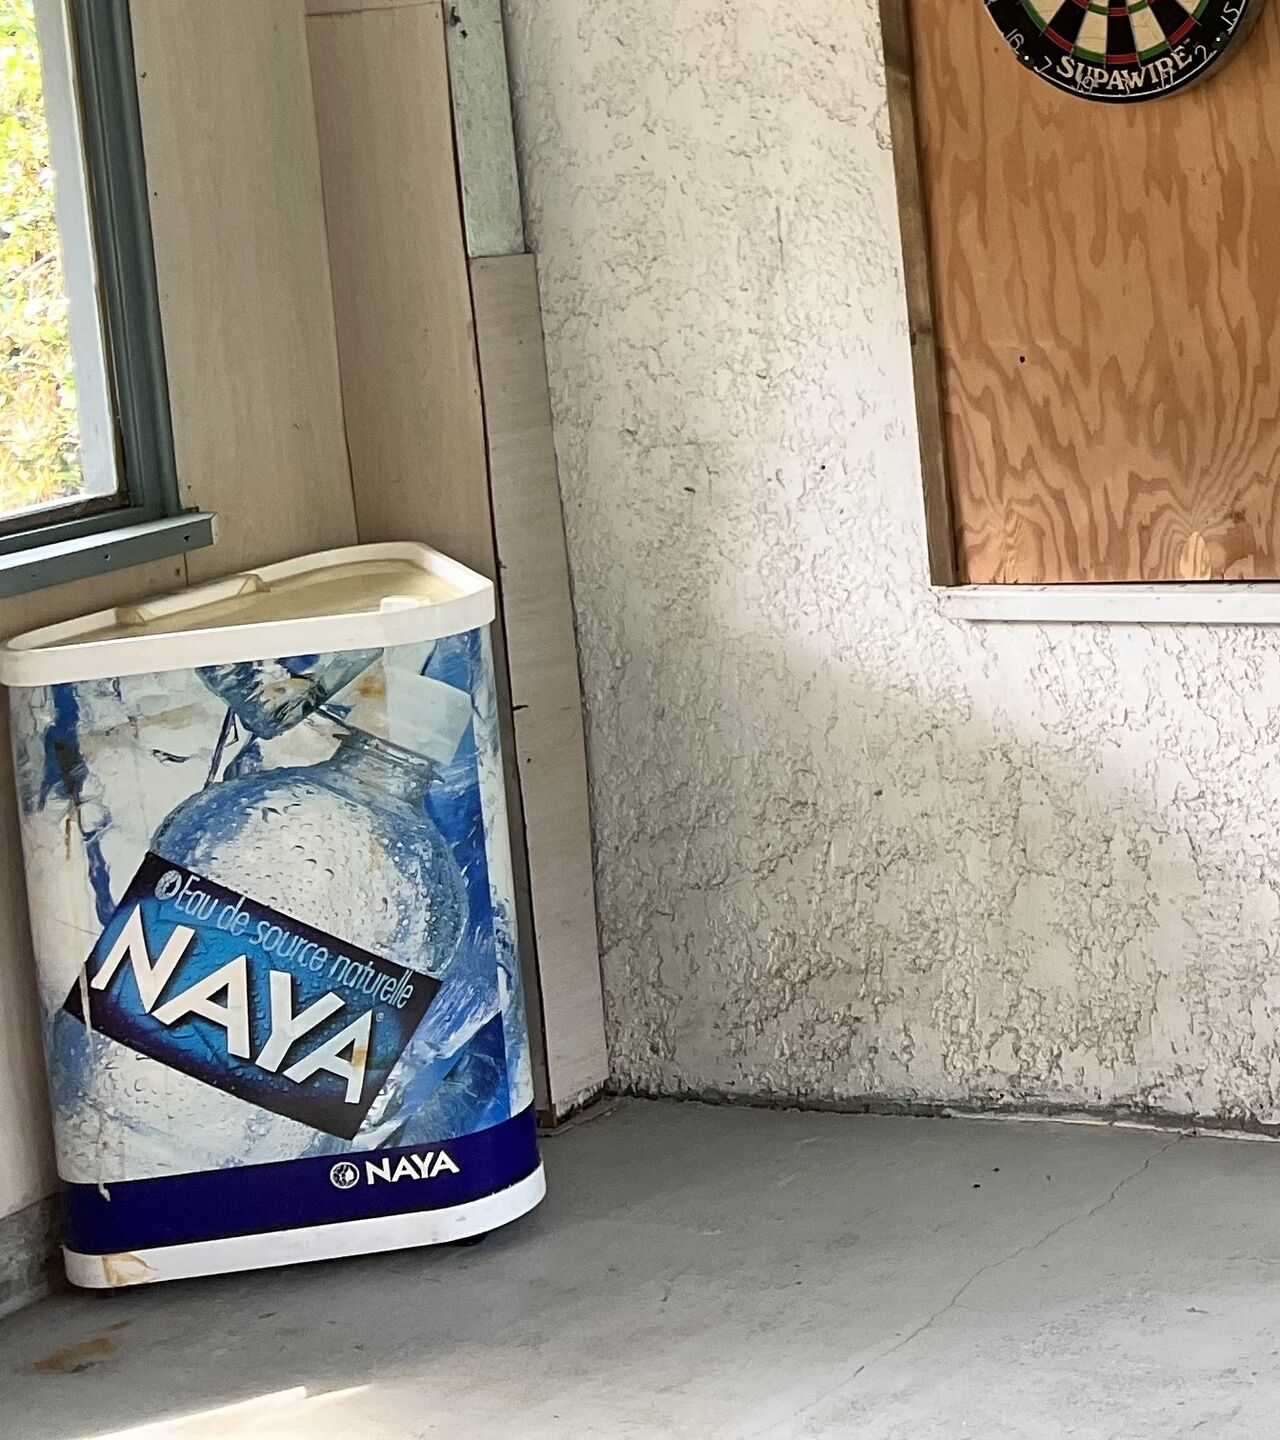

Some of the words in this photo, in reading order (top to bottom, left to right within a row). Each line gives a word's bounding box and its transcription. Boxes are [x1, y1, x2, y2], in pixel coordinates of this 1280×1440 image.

[1056, 45, 1193, 91] SUPAWIRE
[174, 874, 219, 921] Eau
[217, 896, 250, 936] de
[249, 920, 329, 971] source
[329, 954, 414, 1009] naturelle
[91, 904, 378, 1105] NAYA
[366, 1150, 460, 1183] NAYA
